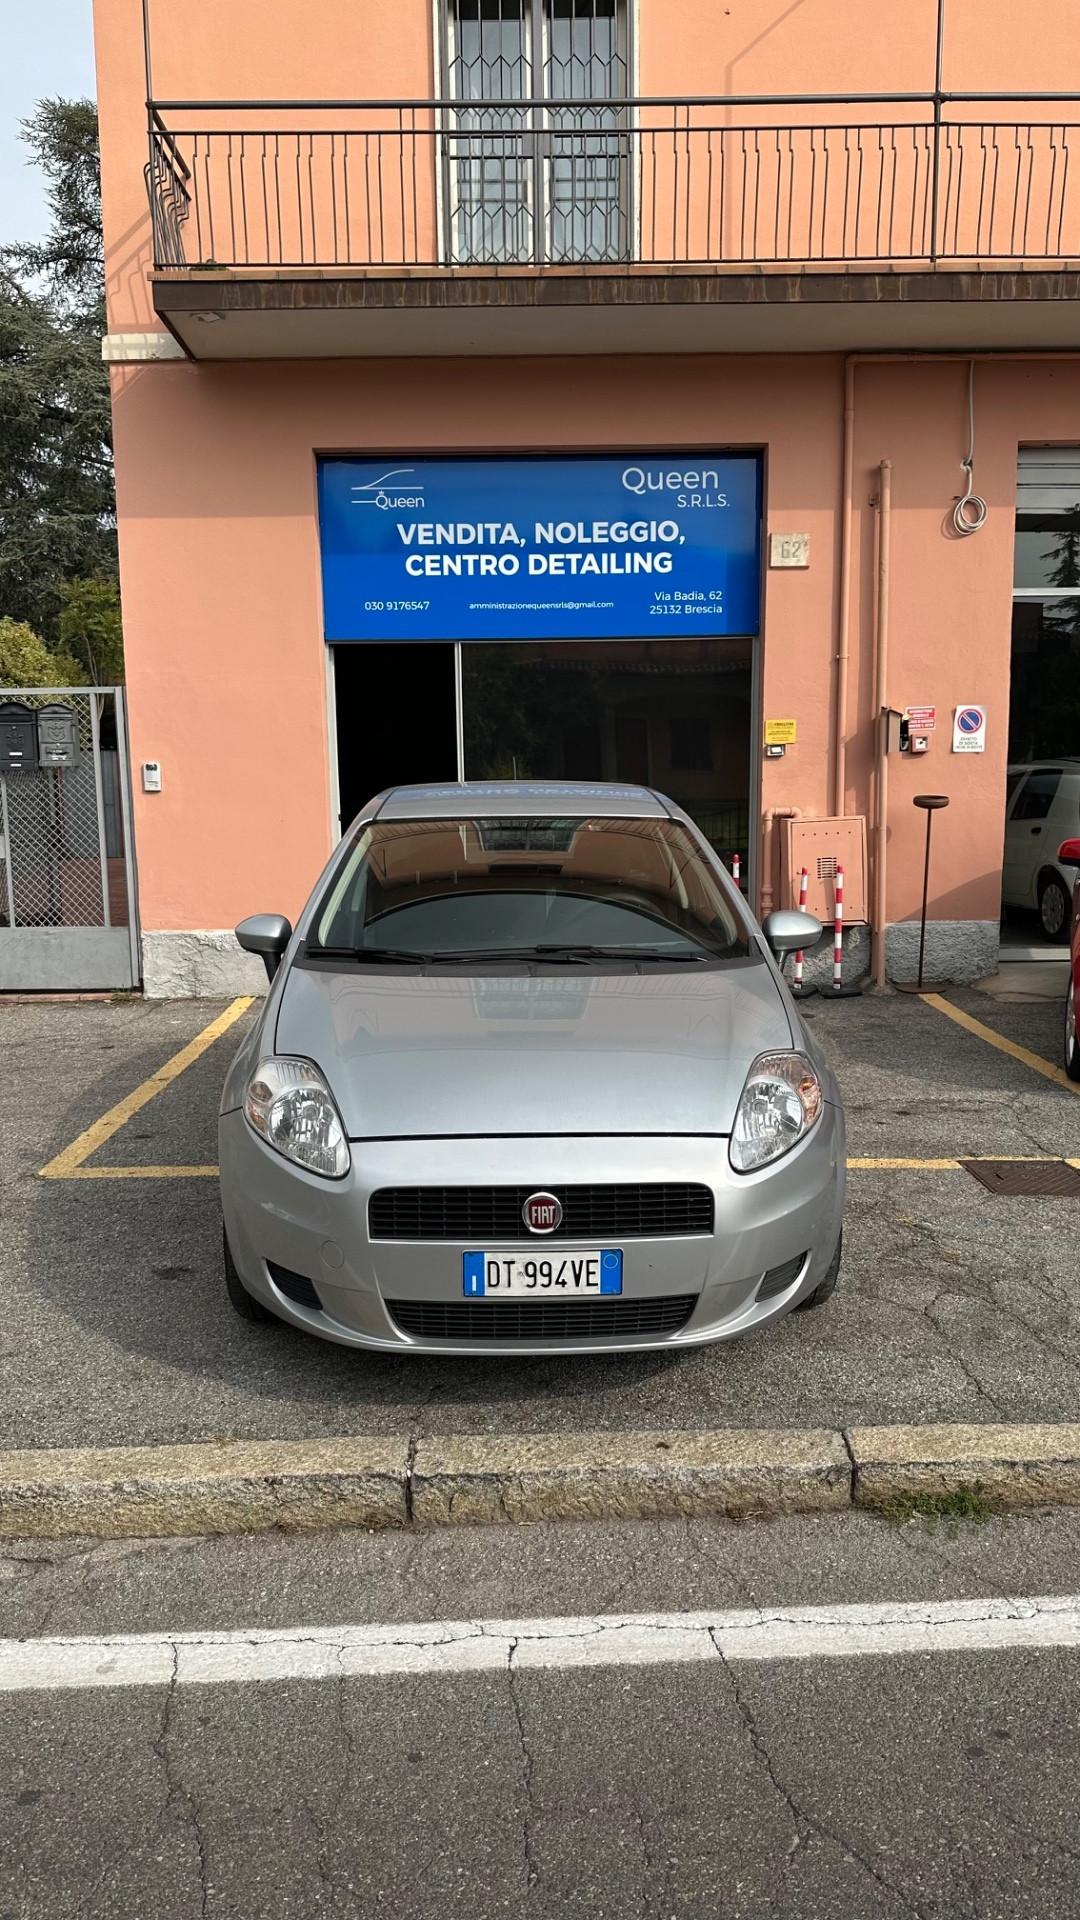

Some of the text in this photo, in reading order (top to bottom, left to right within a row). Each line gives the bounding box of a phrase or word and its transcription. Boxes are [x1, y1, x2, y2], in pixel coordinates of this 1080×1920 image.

[622, 467, 718, 494] Queen
[376, 494, 425, 510] Queen
[677, 494, 730, 508] S.R.L.S.
[397, 521, 686, 547] VENDITA, NOLEGGIO,
[405, 552, 673, 576] CENTRO DETAILING
[654, 591, 723, 602] Via Badia, 62
[364, 601, 430, 611] 030 9176547
[469, 600, 614, 611] amministrazionequeensrls@gmail.com
[650, 604, 723, 615] 25132 Brescia
[531, 1205, 555, 1224] FIAT
